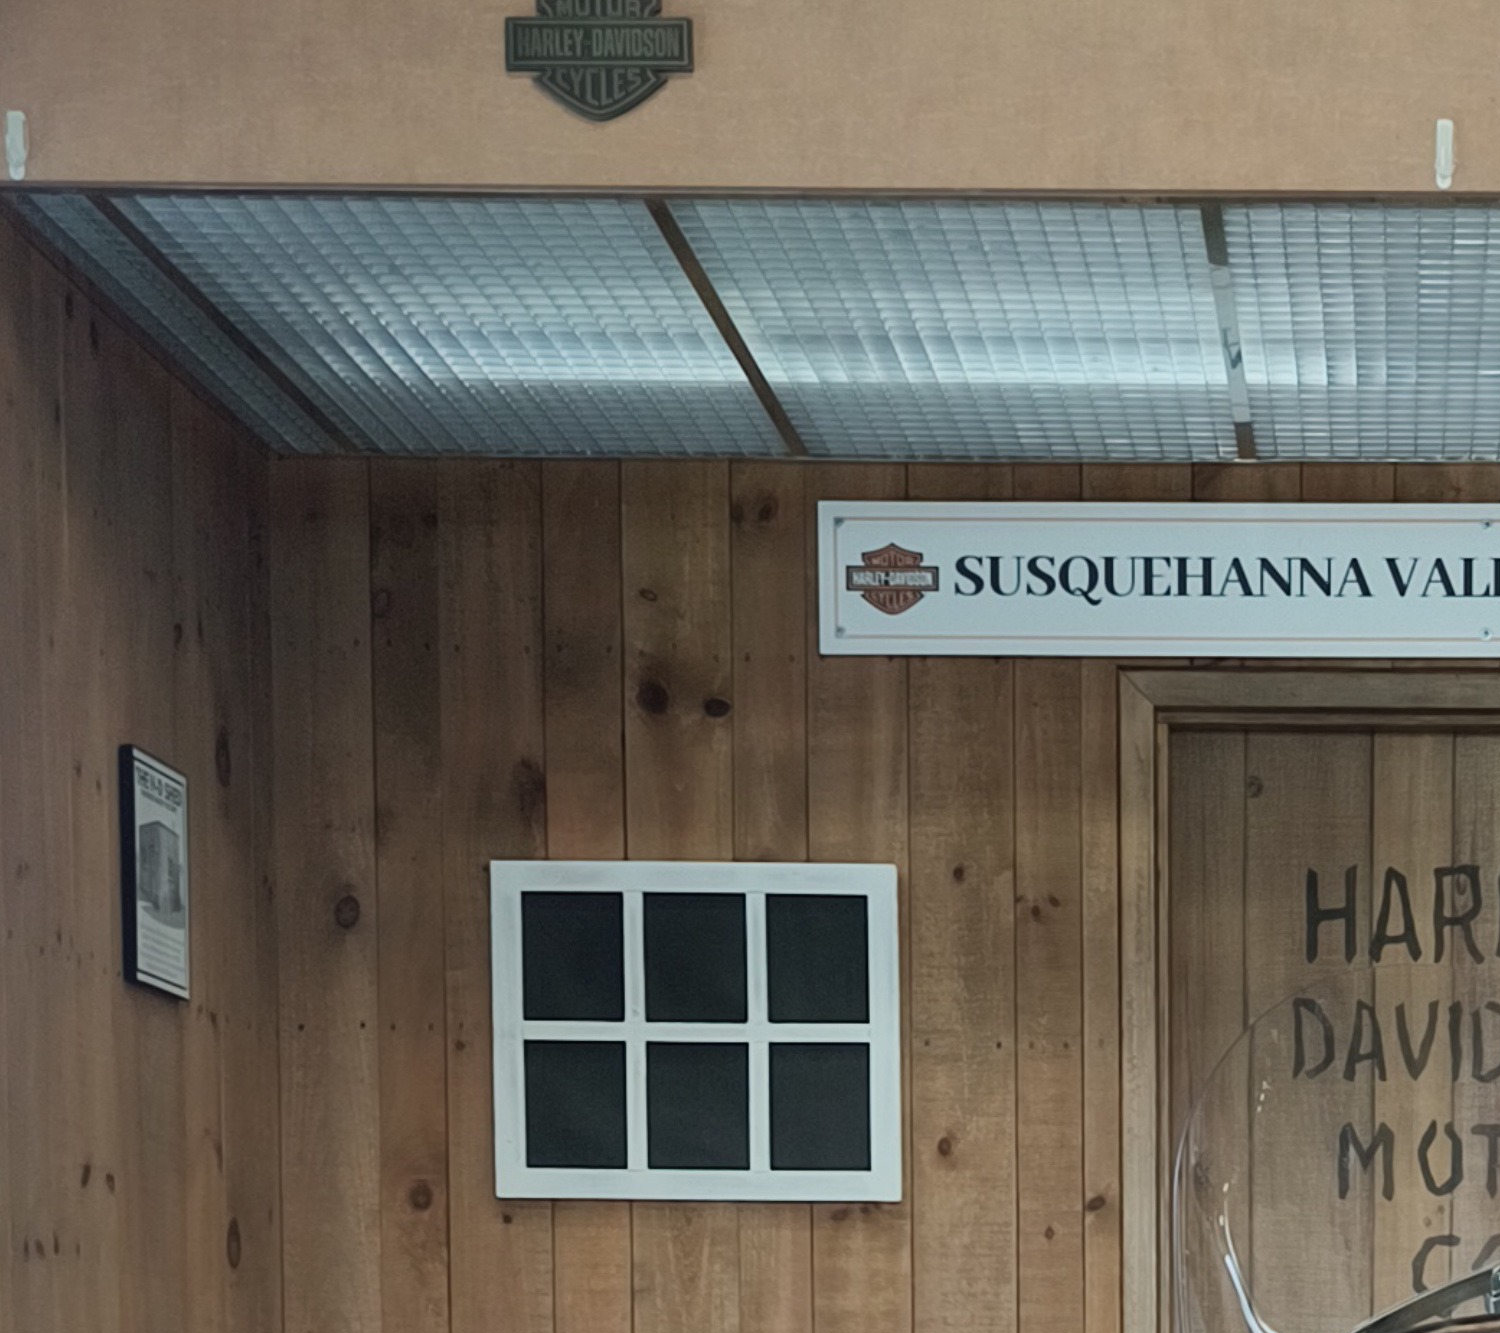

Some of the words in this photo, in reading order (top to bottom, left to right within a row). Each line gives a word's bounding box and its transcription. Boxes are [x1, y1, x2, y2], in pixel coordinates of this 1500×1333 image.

[517, 28, 679, 58] HARLEY-DAVIDSON
[555, 67, 642, 106] CYCLES
[954, 555, 1375, 606] SUSQUEHANNA
